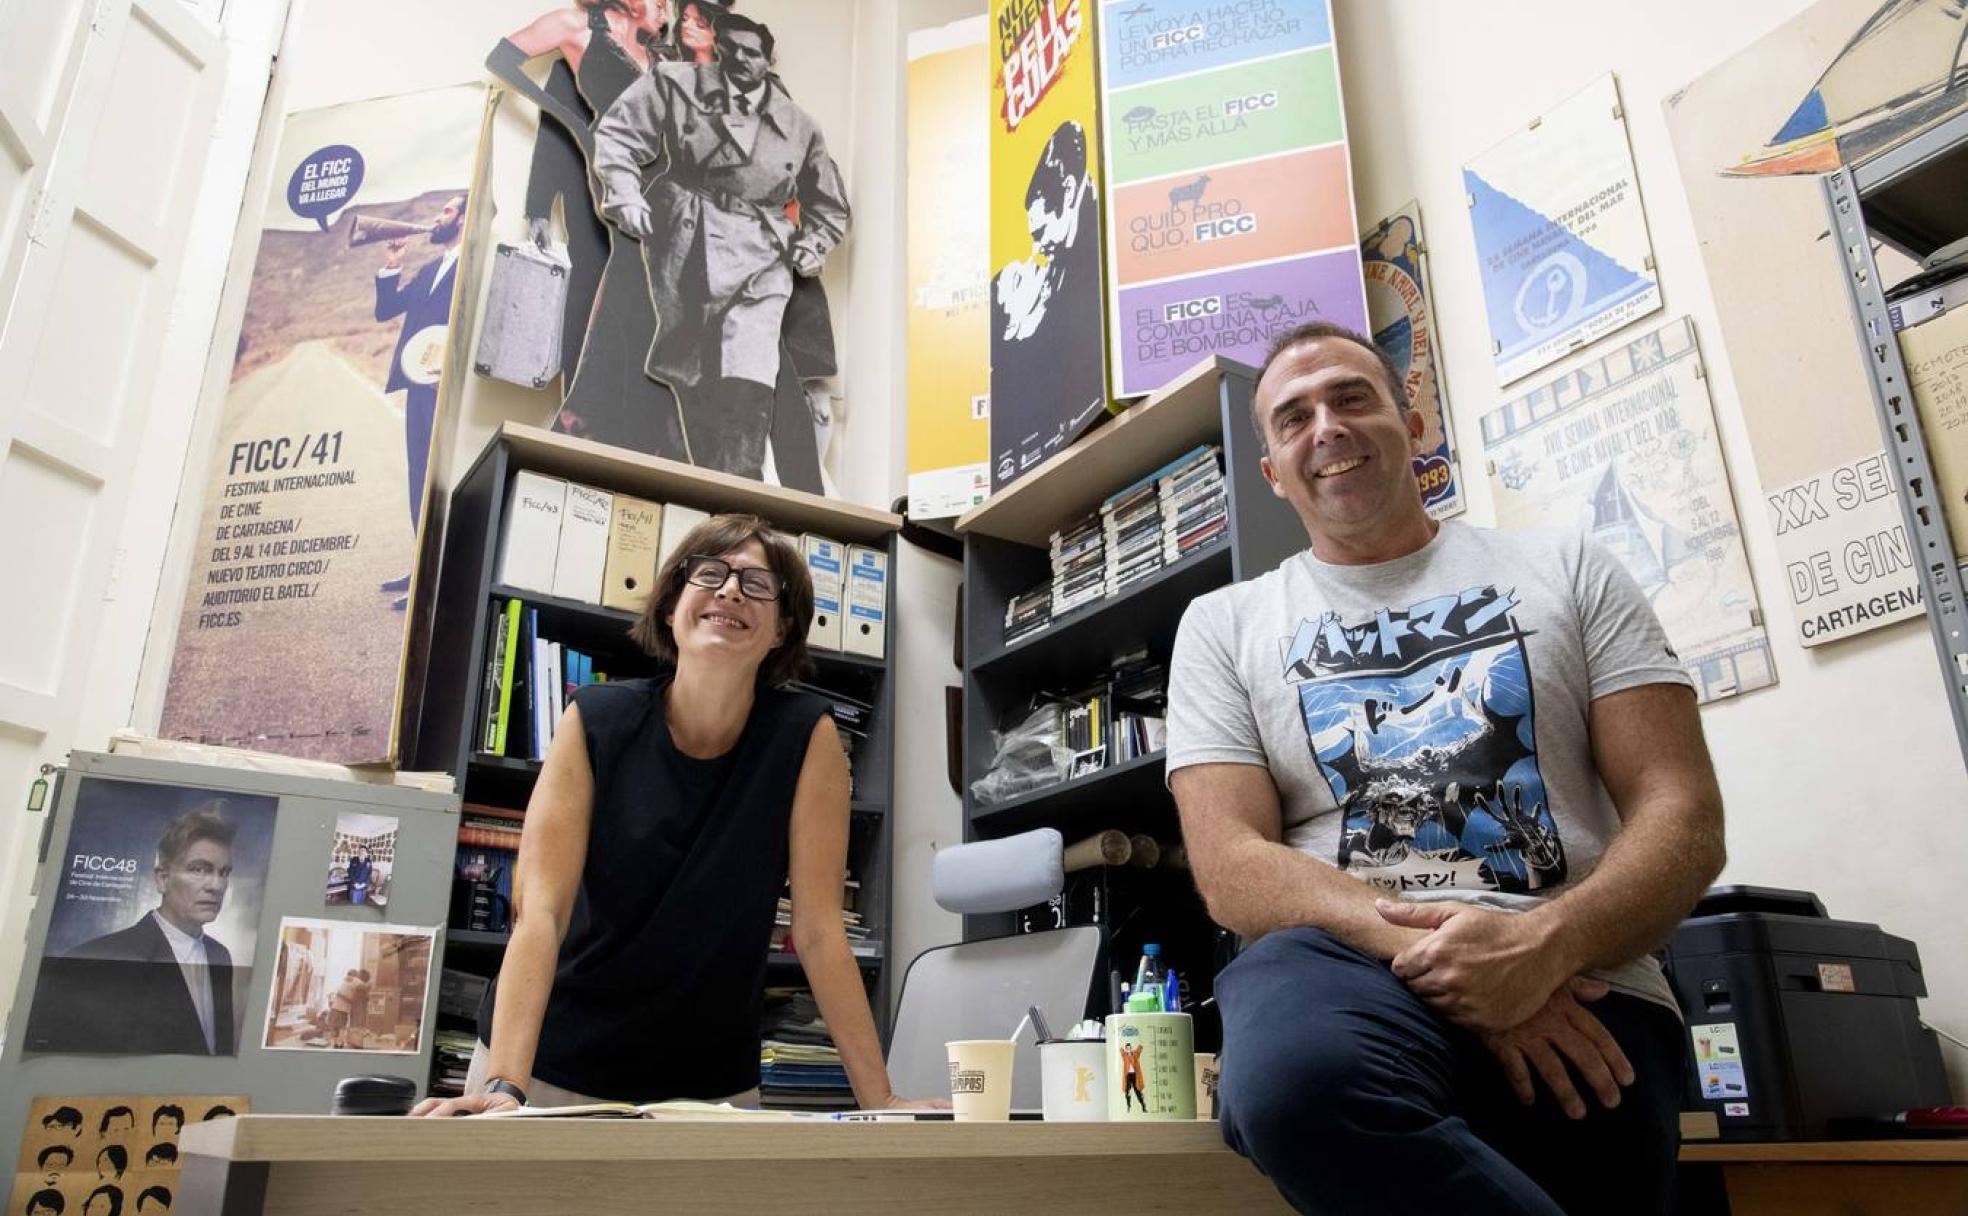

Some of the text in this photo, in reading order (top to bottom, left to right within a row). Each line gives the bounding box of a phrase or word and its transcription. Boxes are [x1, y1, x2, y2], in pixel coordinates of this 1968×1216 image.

[1119, 22, 1140, 41] LE
[1145, 16, 1186, 35] VOY
[1190, 10, 1206, 25] A
[1119, 9, 1285, 56] UN FICC QUE NO
[1193, 18, 1301, 54] RECHAZAR
[1127, 93, 1276, 135] HASTA EL FICC
[1128, 136, 1144, 151] Y
[304, 157, 352, 180] EL FICC
[301, 175, 349, 193] DEL MUNDO
[316, 186, 347, 202] LLEGAR
[1130, 199, 1242, 235] QUID PRO
[1545, 178, 1628, 230] INTERNACIONAL
[1577, 209, 1596, 224] DEL
[1600, 191, 1625, 212] MAR
[1131, 216, 1254, 252] QUO, FICC
[1137, 291, 1252, 327] EL FICC ES
[1137, 300, 1320, 344] COMO UNA CAJA
[1138, 342, 1168, 362] DE
[1413, 326, 1428, 363] DEL
[1564, 411, 1600, 448] SEMANA
[1602, 375, 1679, 429] INTERNACIONAL
[1633, 419, 1657, 446] DEL
[229, 437, 290, 476] FICC
[311, 430, 343, 465] 41
[224, 470, 357, 498] FESTIVAL INTERNACIONAL
[1417, 464, 1449, 492] 993
[220, 501, 262, 519] DE CINE
[1769, 479, 1829, 536] XX
[216, 526, 230, 541] DE
[212, 546, 231, 562] DEL
[233, 545, 241, 560] 9
[241, 545, 255, 560] AL
[258, 543, 271, 558] 14
[272, 541, 288, 556] DE
[207, 567, 243, 584] NUEVO
[244, 563, 285, 581] TEATRO
[1787, 551, 1840, 605] DE
[202, 586, 261, 607] AUDITORIO
[262, 585, 275, 600] EL
[198, 611, 242, 629] FICC.ES
[73, 854, 137, 873] FICC48
